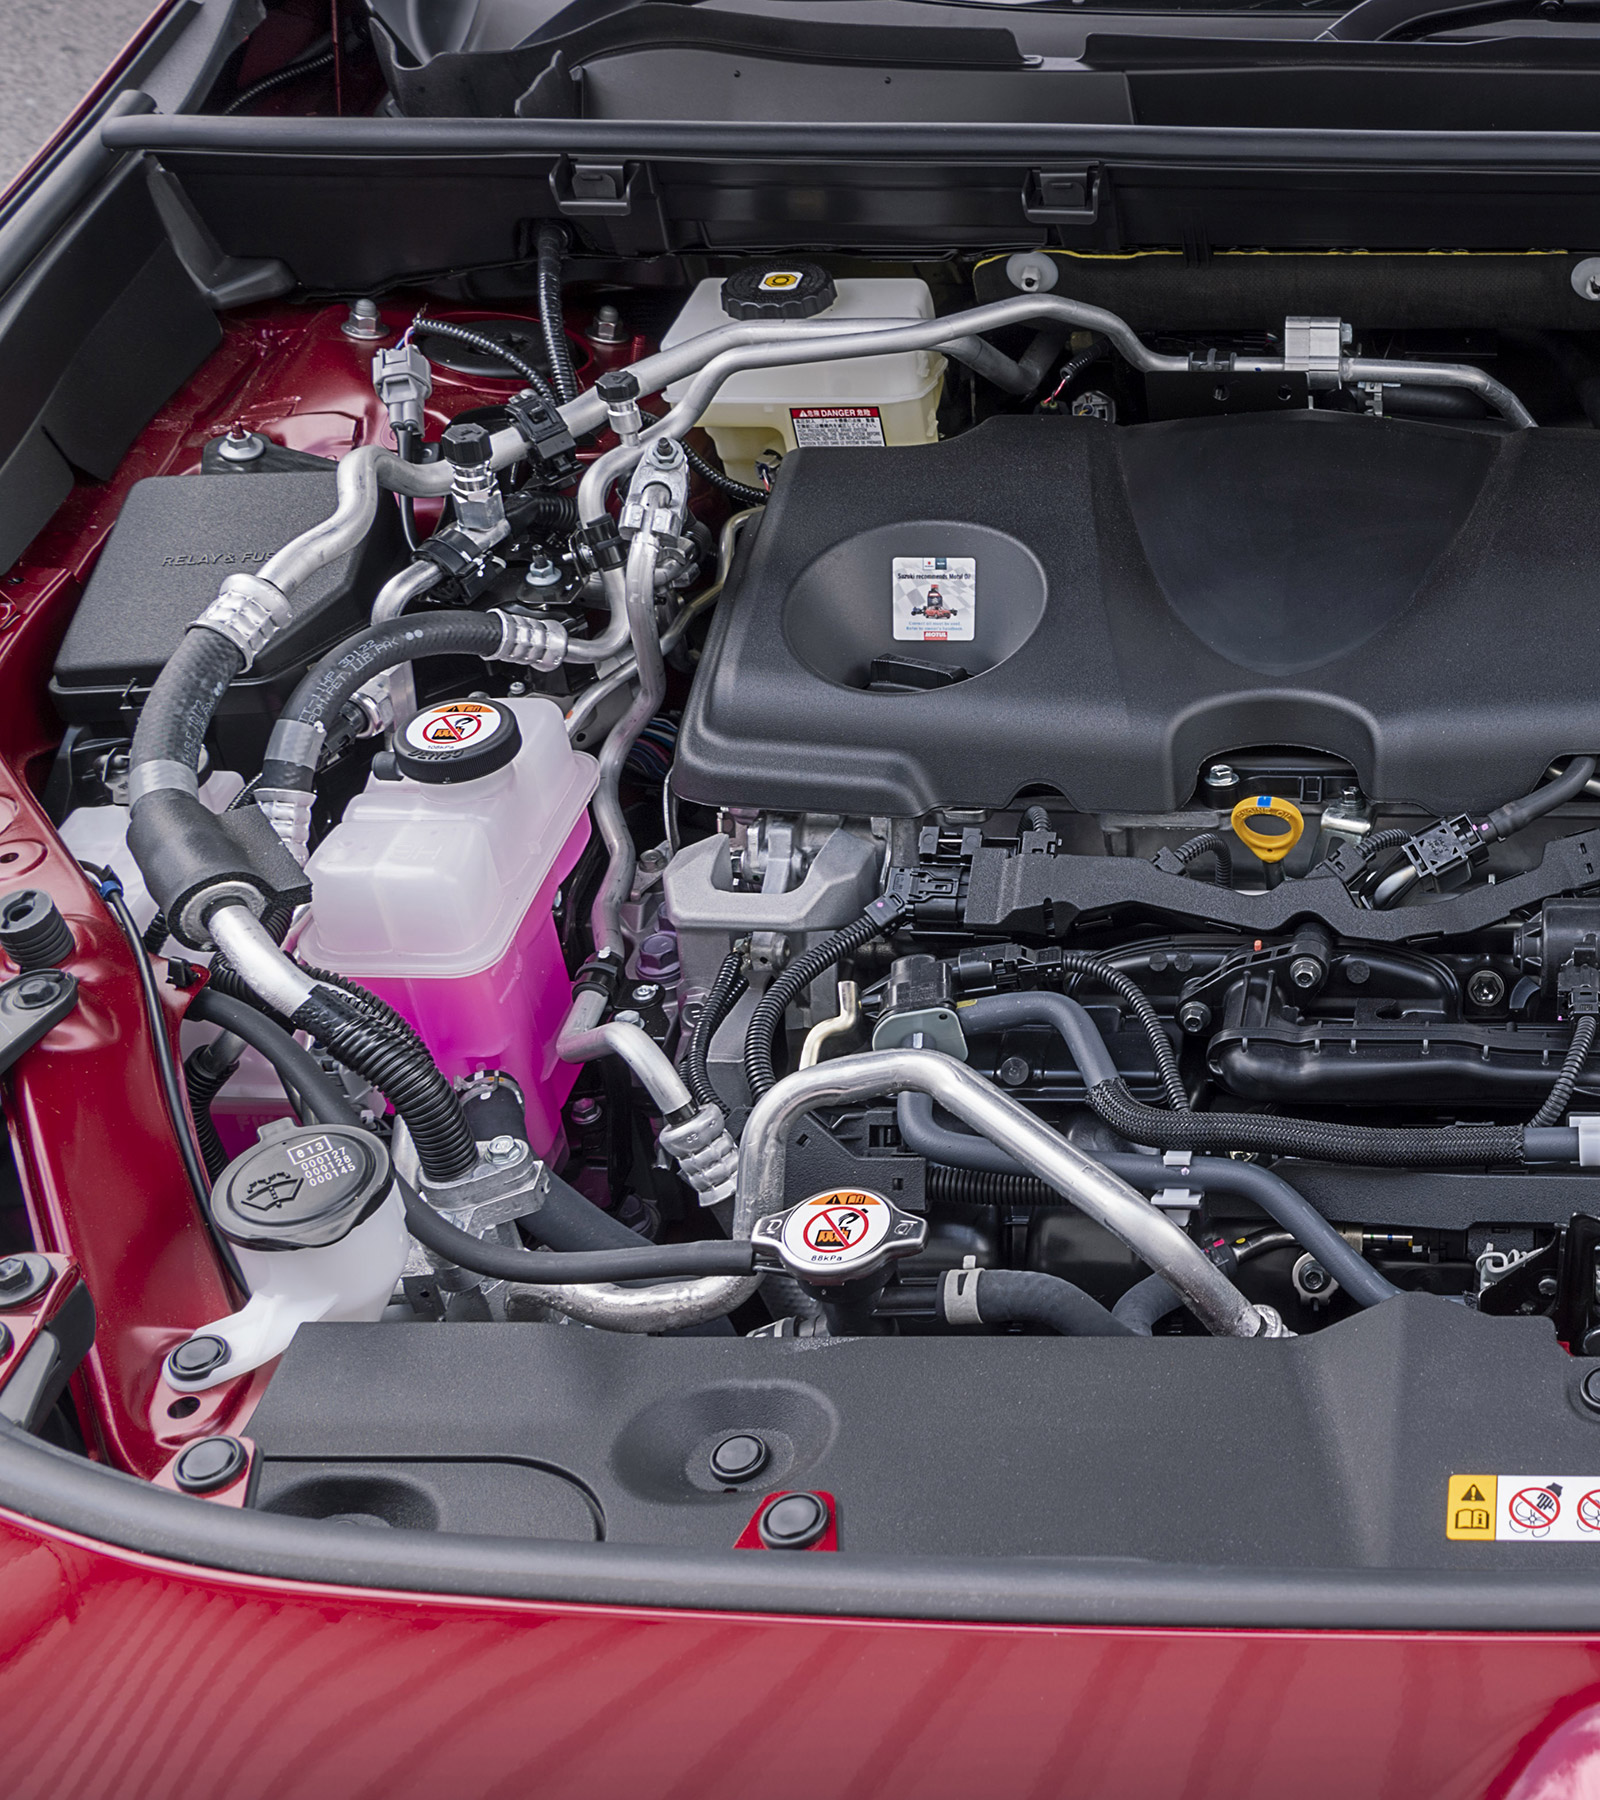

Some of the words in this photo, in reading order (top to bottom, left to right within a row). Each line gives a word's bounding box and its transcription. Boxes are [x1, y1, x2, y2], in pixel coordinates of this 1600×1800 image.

[820, 409, 856, 417] DANGER
[161, 553, 223, 566] RELAY
[224, 552, 235, 564] &
[296, 1142, 325, 1159] e13
[301, 1146, 346, 1171] 000127
[304, 1155, 351, 1179] 000128
[309, 1163, 356, 1187] 000145
[811, 1254, 842, 1262] 88kPa
